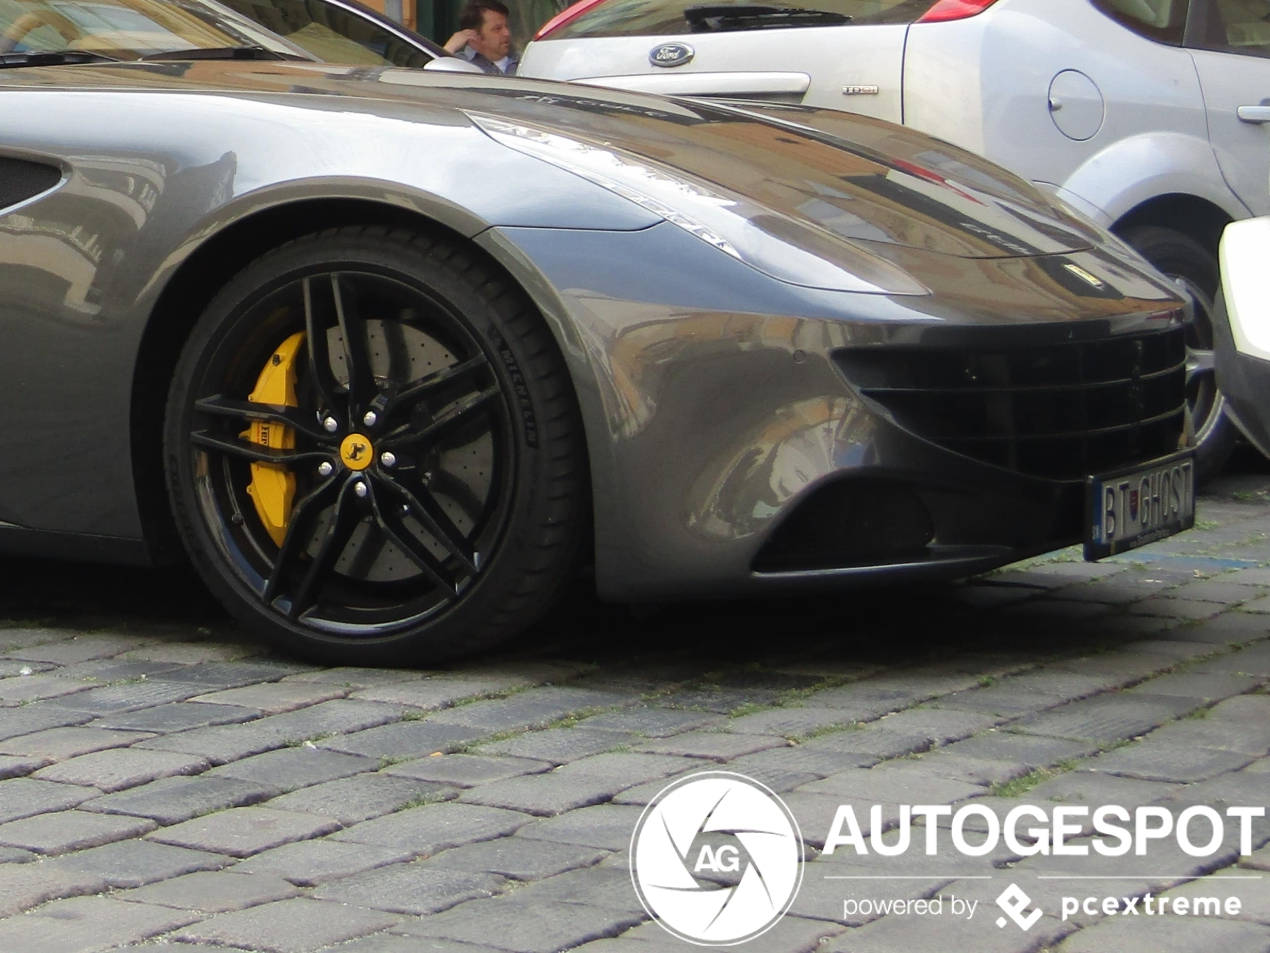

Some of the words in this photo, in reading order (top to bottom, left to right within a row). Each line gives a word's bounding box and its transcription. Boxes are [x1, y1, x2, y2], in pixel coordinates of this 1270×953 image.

[656, 47, 680, 59] Ford
[501, 350, 537, 442] MICHELIN
[1103, 481, 1130, 541] BT
[1138, 463, 1191, 527] GHOST
